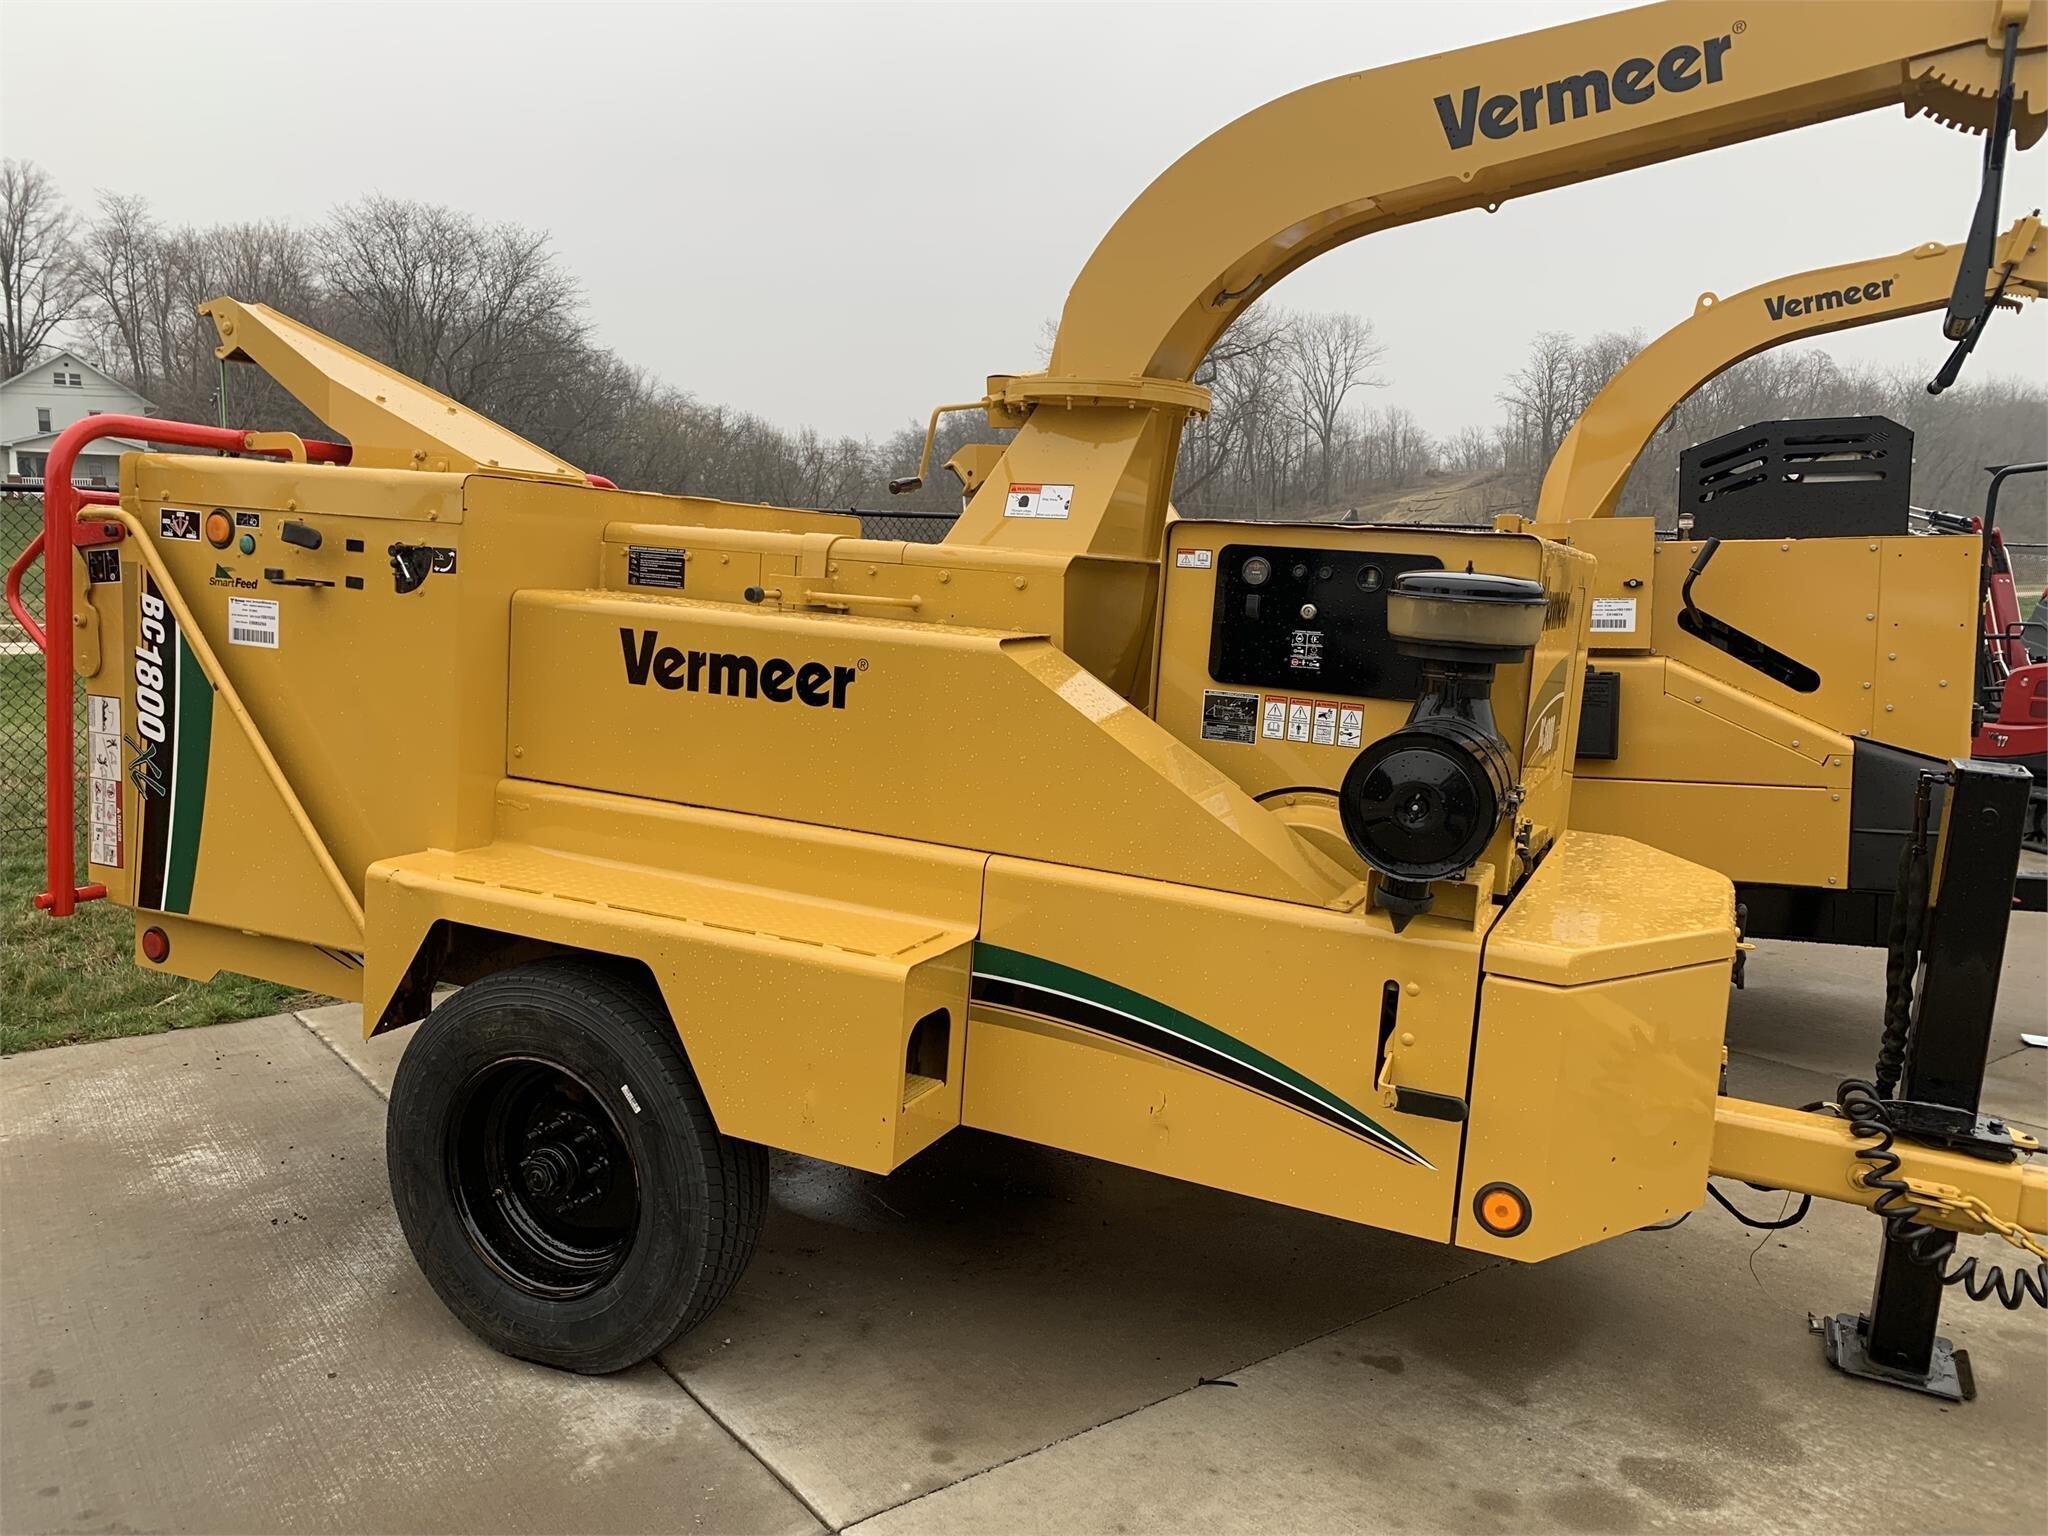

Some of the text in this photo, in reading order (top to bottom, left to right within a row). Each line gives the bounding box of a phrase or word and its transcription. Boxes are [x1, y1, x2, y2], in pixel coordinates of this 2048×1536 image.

[1433, 34, 1732, 151] Vermeer
[1764, 279, 1893, 321] Vermeer
[619, 627, 856, 709] Vermeer
